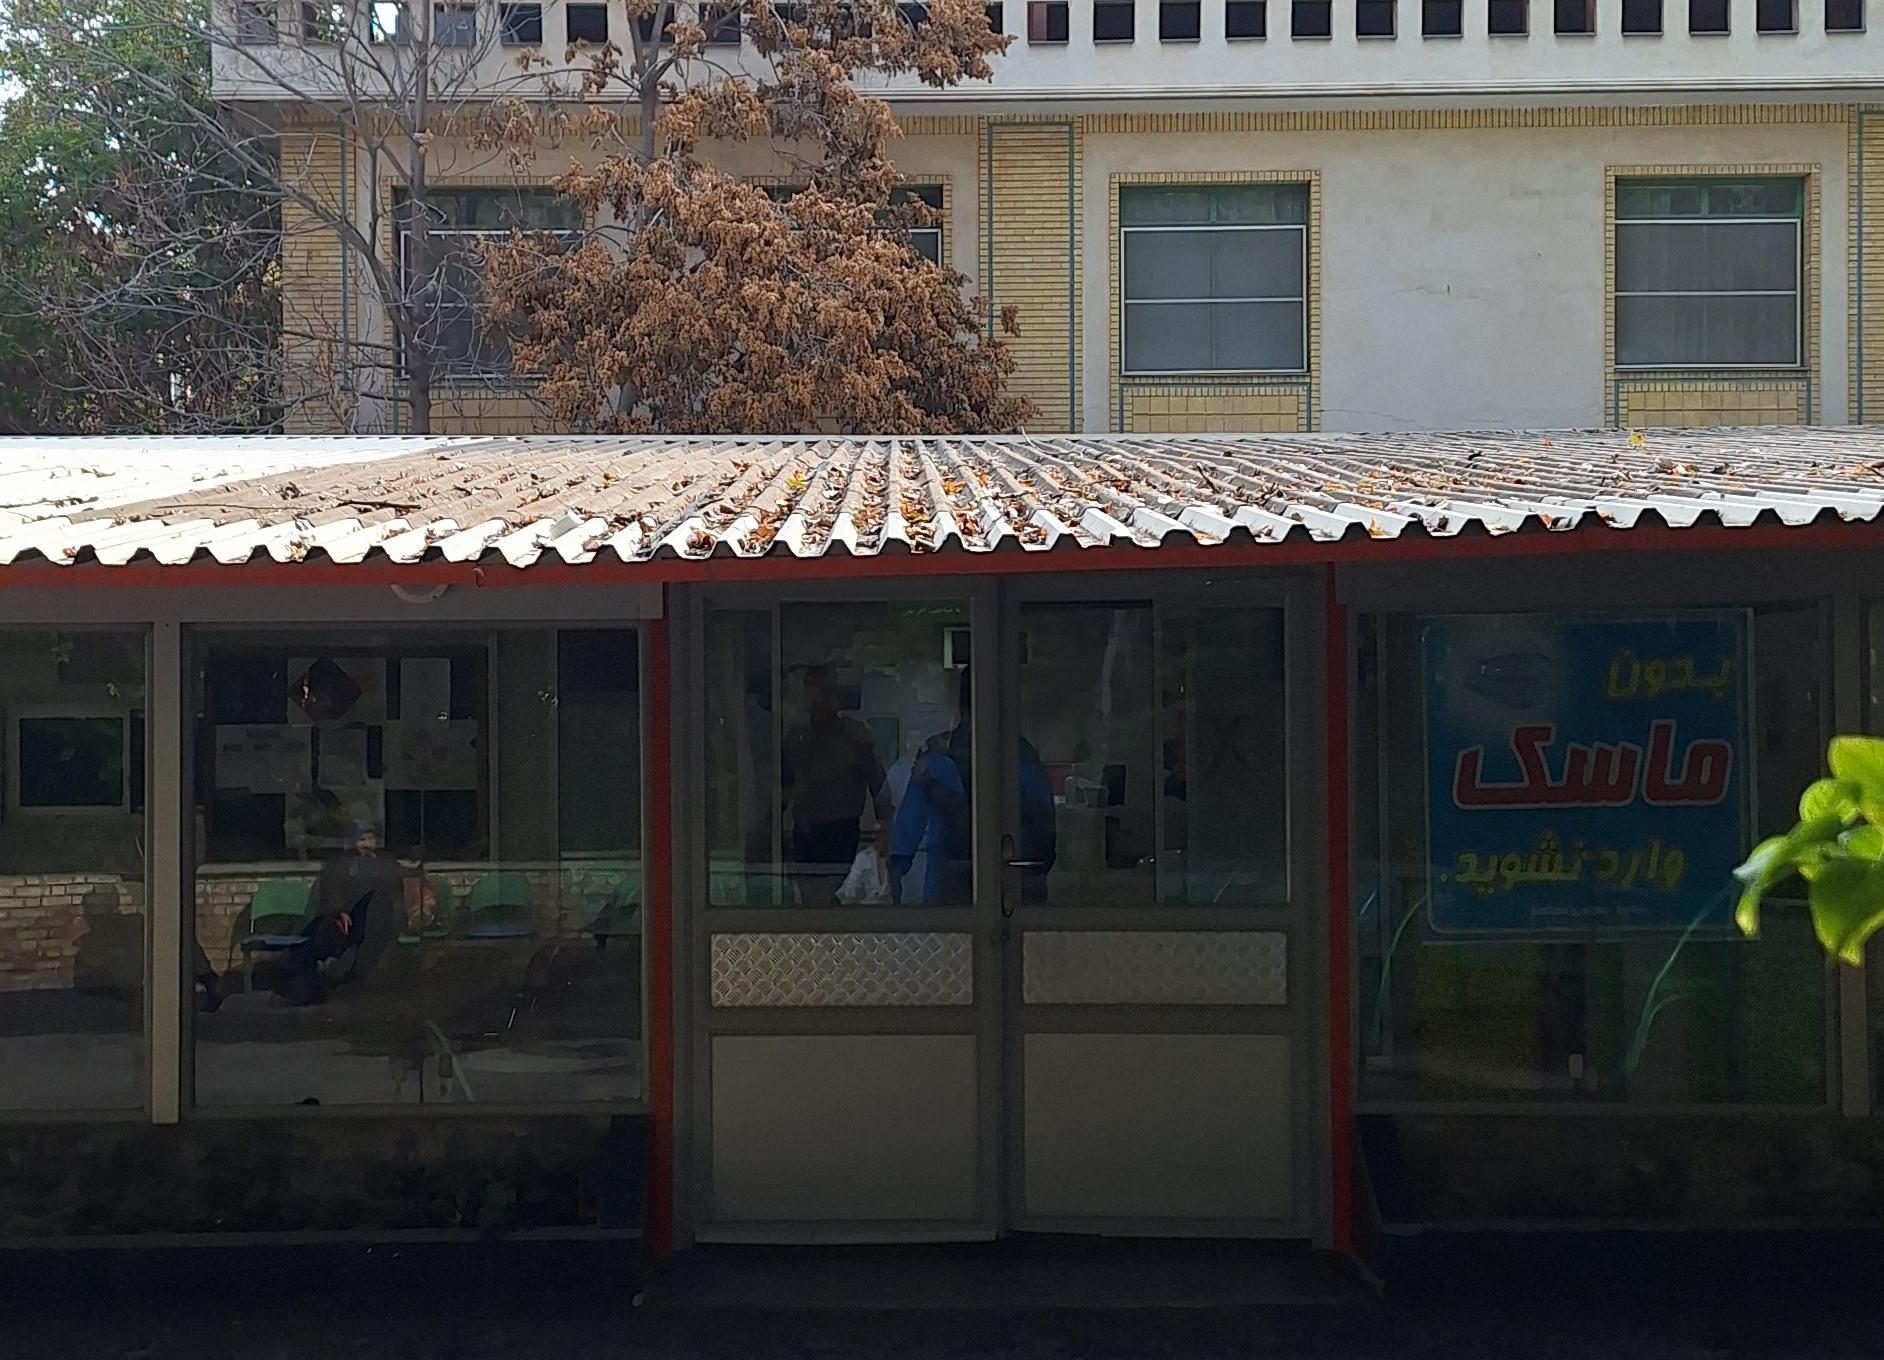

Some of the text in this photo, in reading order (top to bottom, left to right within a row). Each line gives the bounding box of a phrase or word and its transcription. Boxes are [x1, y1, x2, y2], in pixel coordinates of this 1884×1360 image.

[1606, 650, 1731, 698] بدون
[1453, 720, 1732, 809] ماسک
[1598, 839, 1685, 889] وارد
